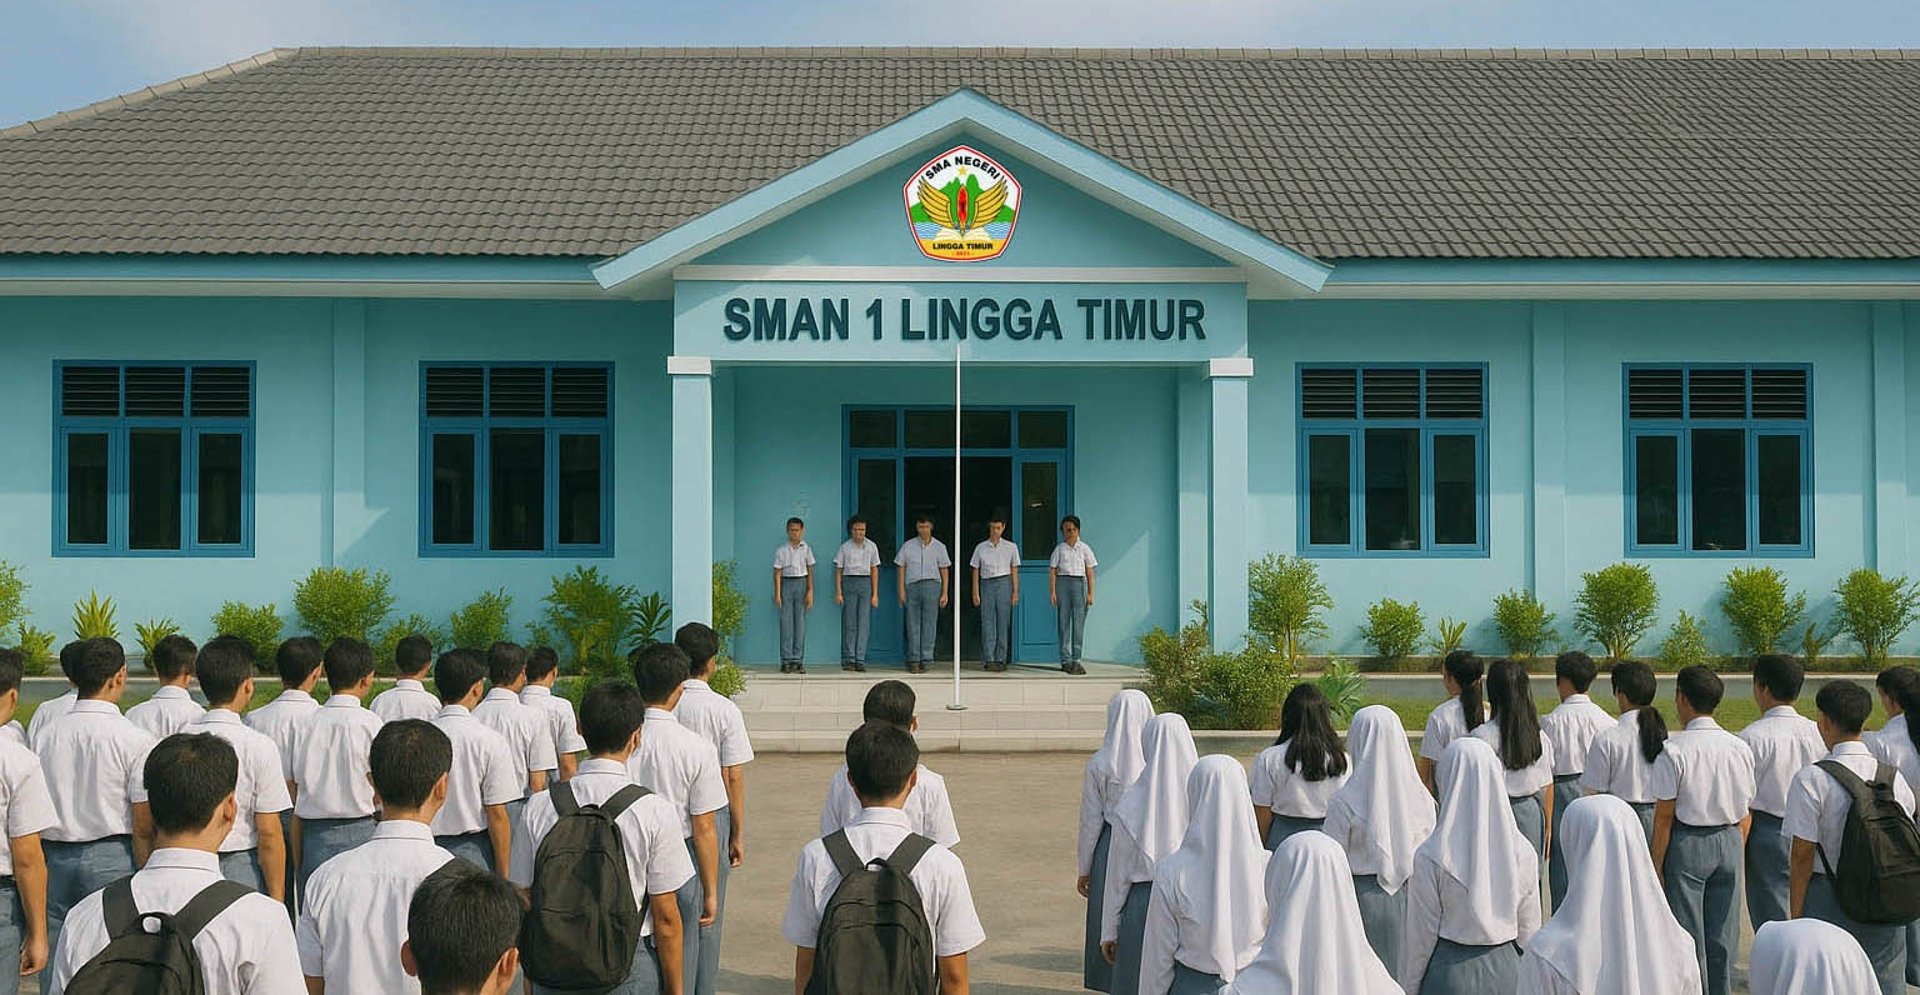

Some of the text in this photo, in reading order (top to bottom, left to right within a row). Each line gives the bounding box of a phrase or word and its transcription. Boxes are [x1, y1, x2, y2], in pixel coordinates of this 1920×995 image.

[925, 156, 1000, 180] SMA NEGERI
[723, 298, 1206, 341] SMAN 1 LINGGA TIMUR
